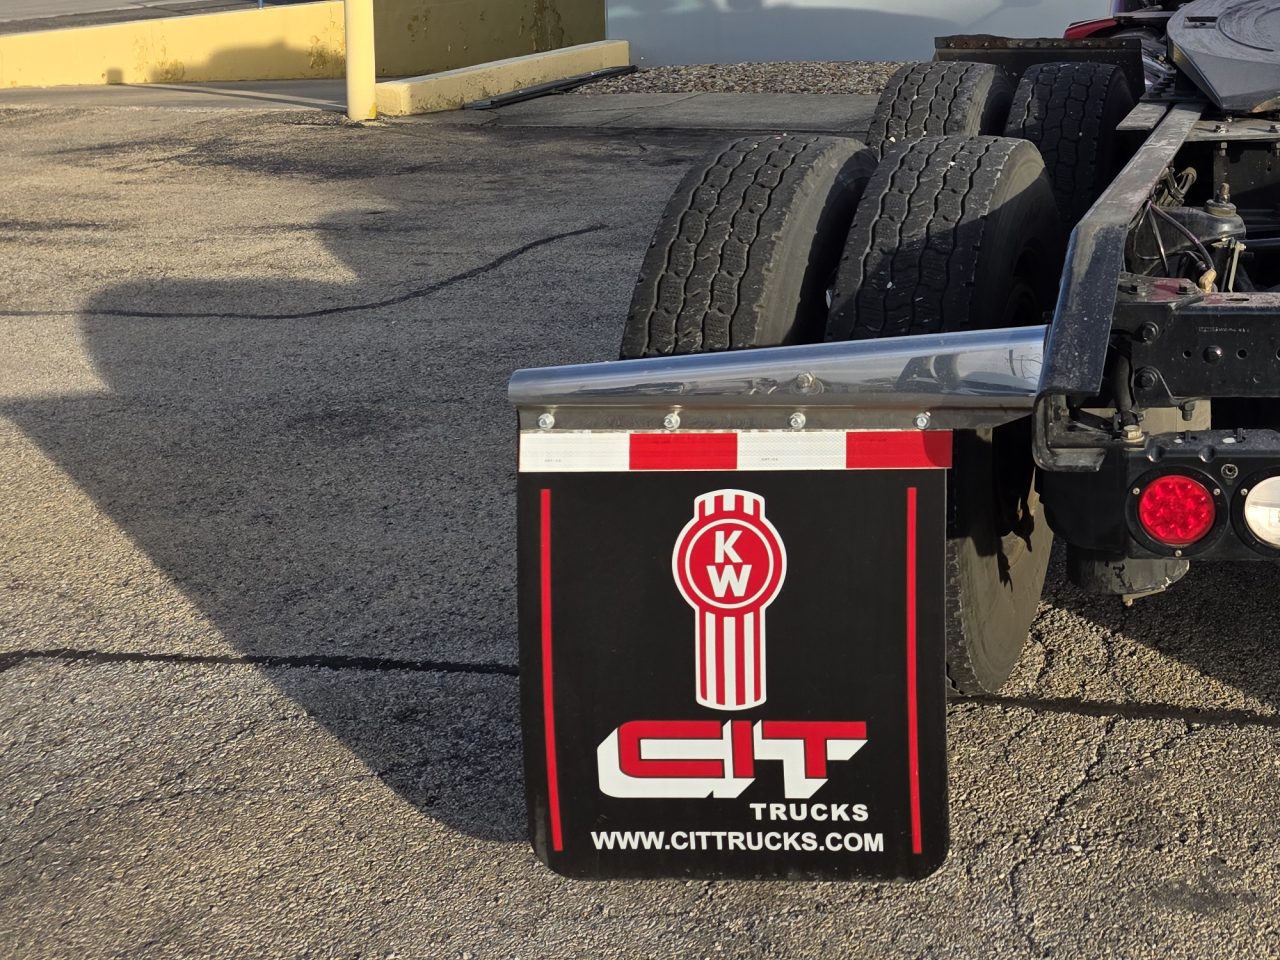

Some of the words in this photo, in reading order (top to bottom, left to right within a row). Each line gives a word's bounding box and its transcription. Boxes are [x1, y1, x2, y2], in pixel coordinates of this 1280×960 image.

[597, 720, 869, 799] CIT
[749, 802, 869, 822] TRUCKS
[590, 830, 885, 853] WWW.CITTRUCKS.COM
